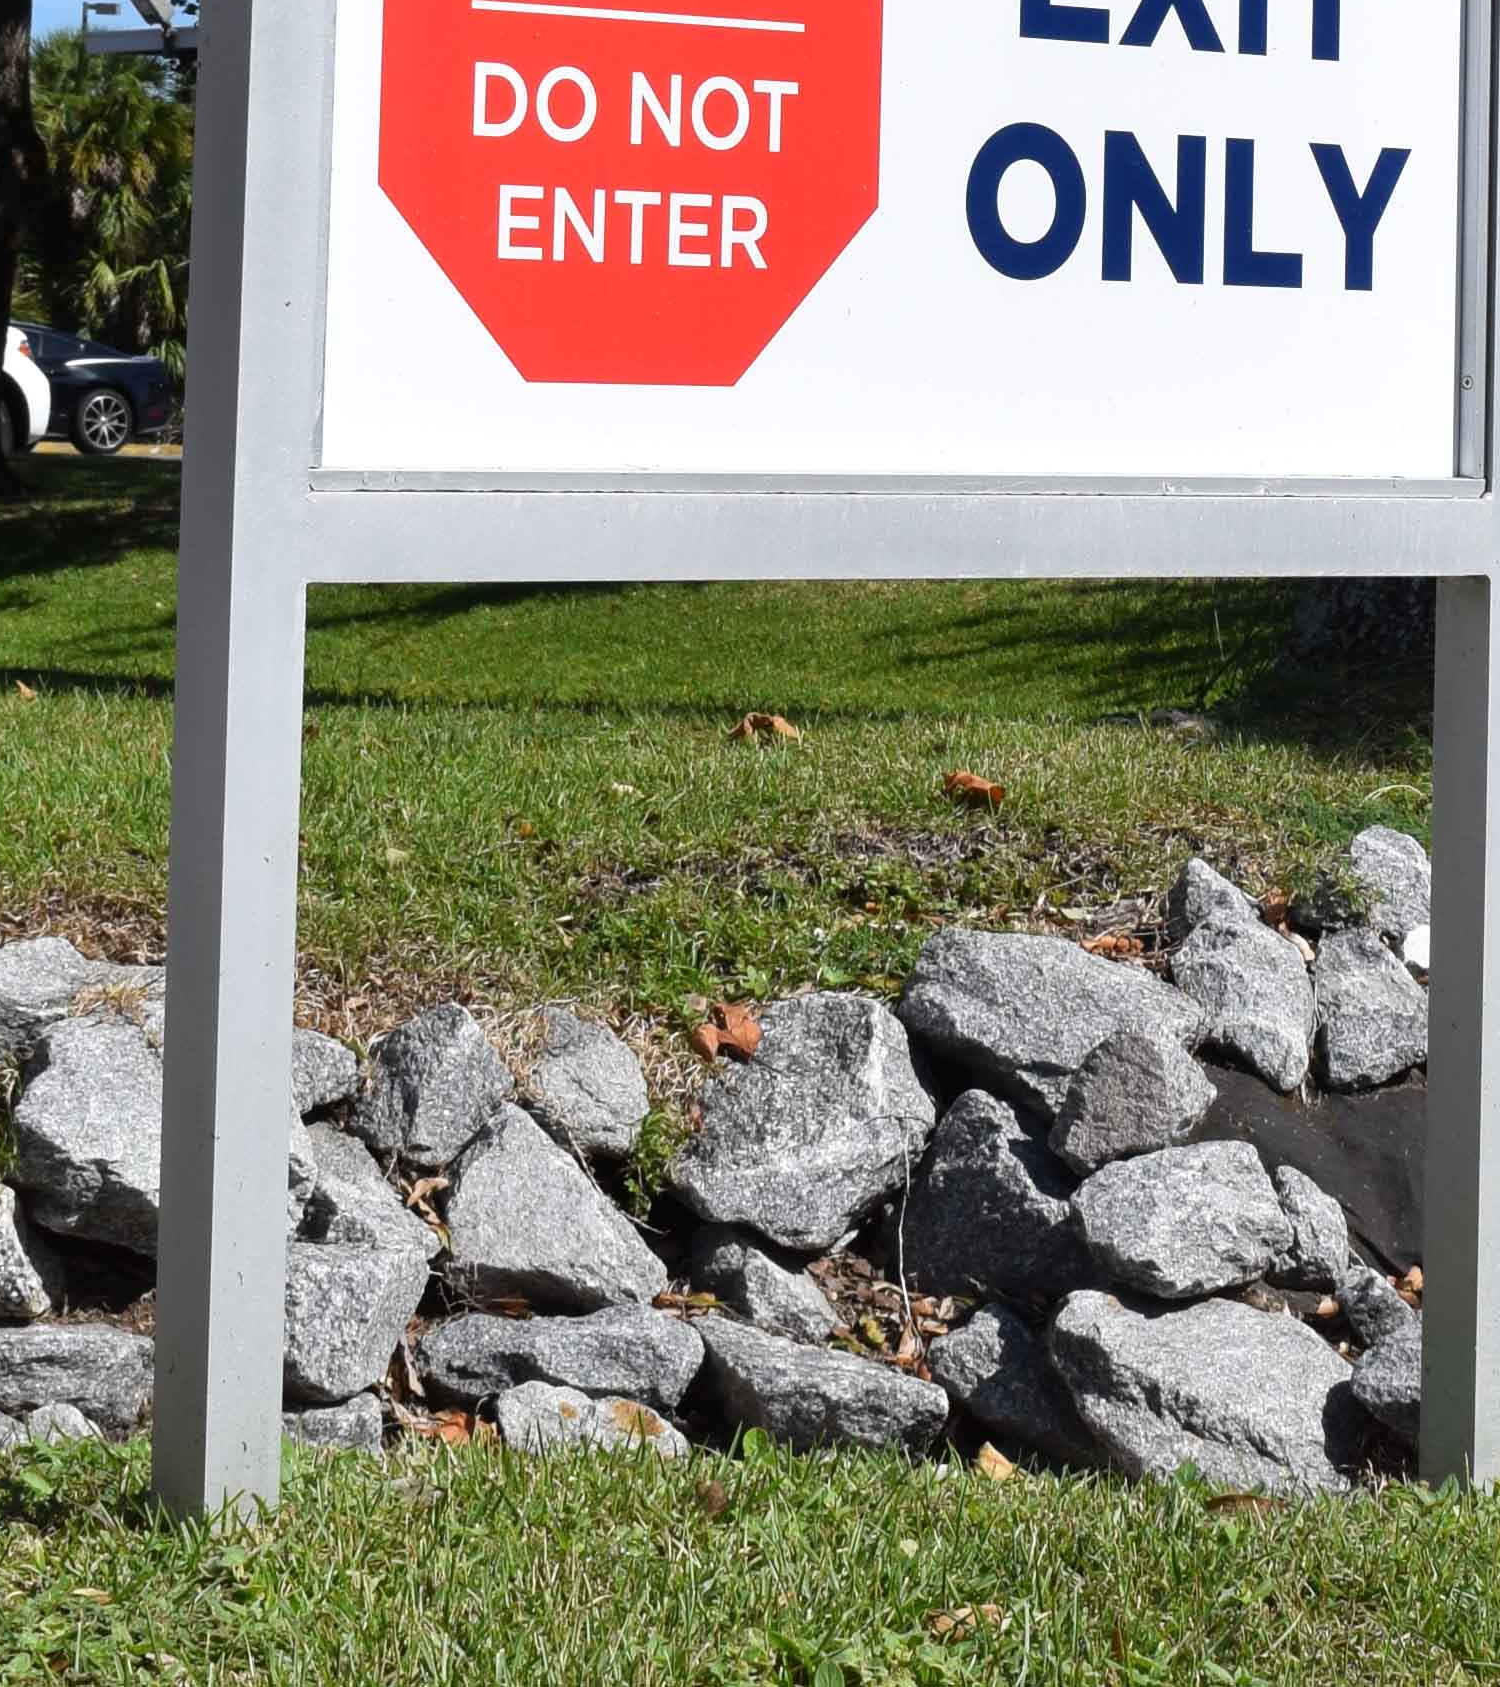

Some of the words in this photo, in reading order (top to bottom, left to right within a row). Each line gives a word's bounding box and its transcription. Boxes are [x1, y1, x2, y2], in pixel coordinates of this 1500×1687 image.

[473, 62, 597, 142] DO
[631, 72, 798, 152] NOT
[498, 185, 767, 268] ENTER
[966, 122, 1411, 291] ONLY
